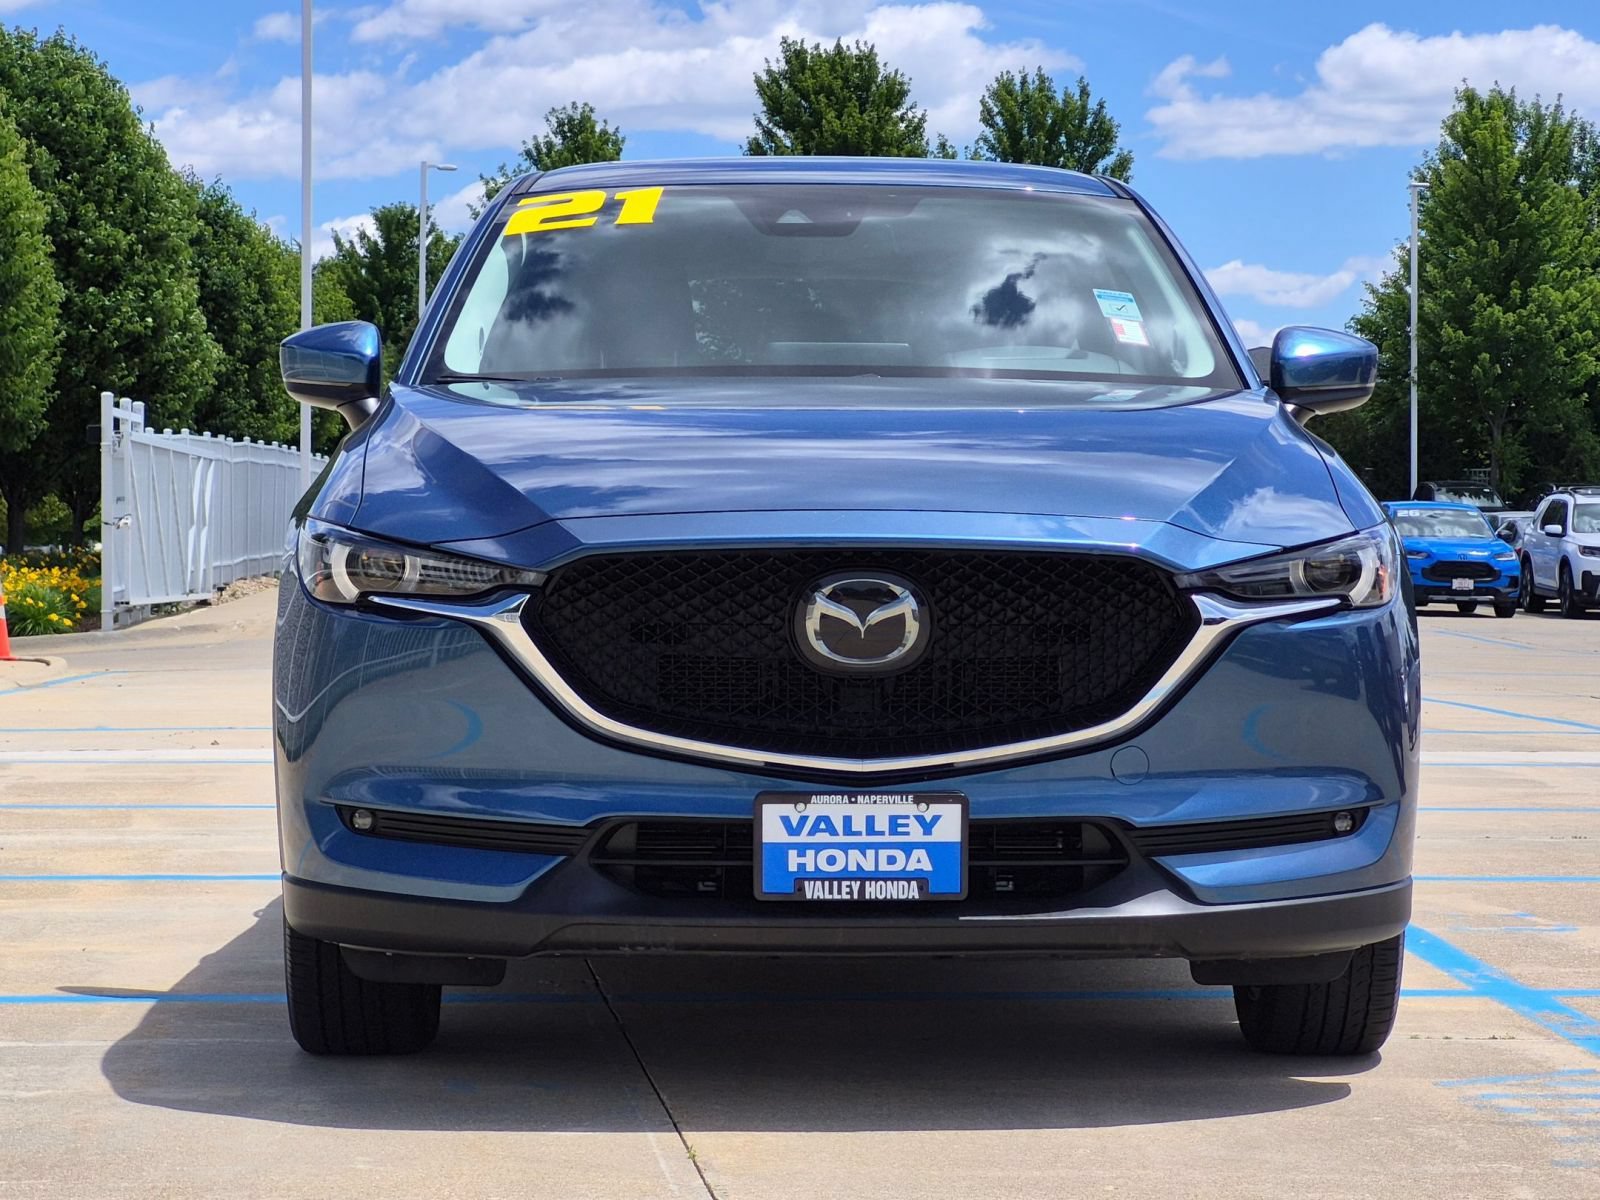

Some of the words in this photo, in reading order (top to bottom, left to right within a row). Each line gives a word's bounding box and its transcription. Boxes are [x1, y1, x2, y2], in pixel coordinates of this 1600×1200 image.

[503, 186, 664, 236] 21
[810, 795, 849, 804] AURORA
[857, 795, 914, 804] NAPERVILLE
[779, 814, 943, 836] VALLEY
[788, 848, 933, 872] HONDA
[804, 880, 860, 900] VALLEY
[865, 880, 919, 899] HONDA
